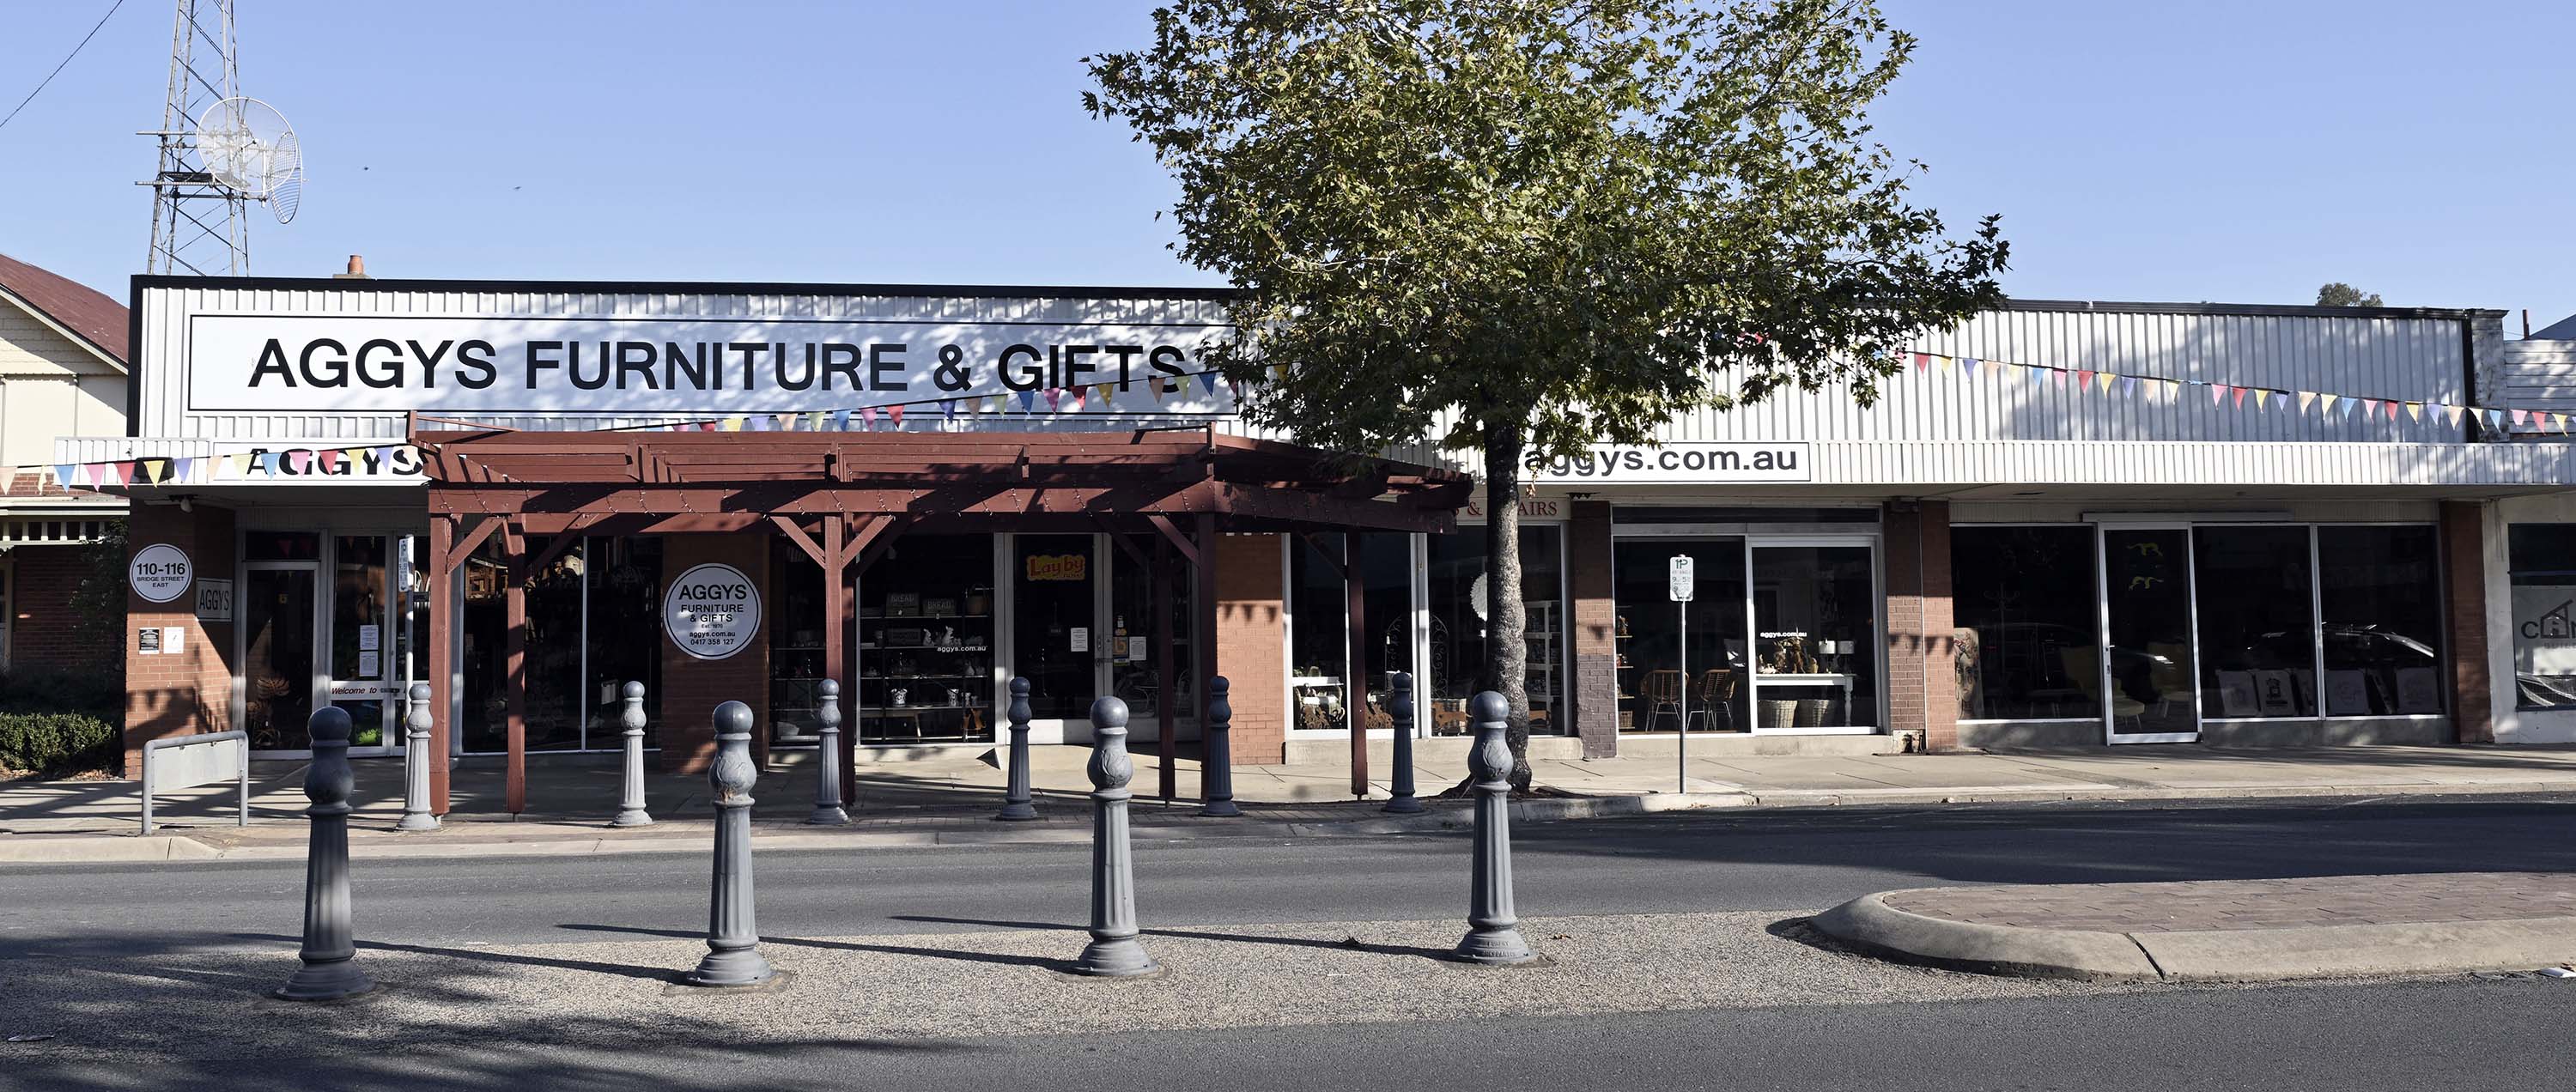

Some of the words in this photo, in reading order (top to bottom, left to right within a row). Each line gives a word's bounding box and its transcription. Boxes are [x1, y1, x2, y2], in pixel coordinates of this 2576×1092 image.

[248, 339, 497, 390] AGGYS
[526, 341, 908, 392] FURNITURE
[933, 344, 972, 392] &
[998, 344, 1186, 393] GIFTS
[246, 448, 423, 476] AGGYS
[1525, 450, 1796, 477] aggys.com.au
[1517, 501, 1558, 516] AIRS
[137, 563, 186, 575] 110-116
[198, 589, 230, 611] AGGYS
[678, 585, 747, 600] AGGYS
[681, 604, 744, 613] FURNITURE
[700, 614, 732, 622] GIFTS
